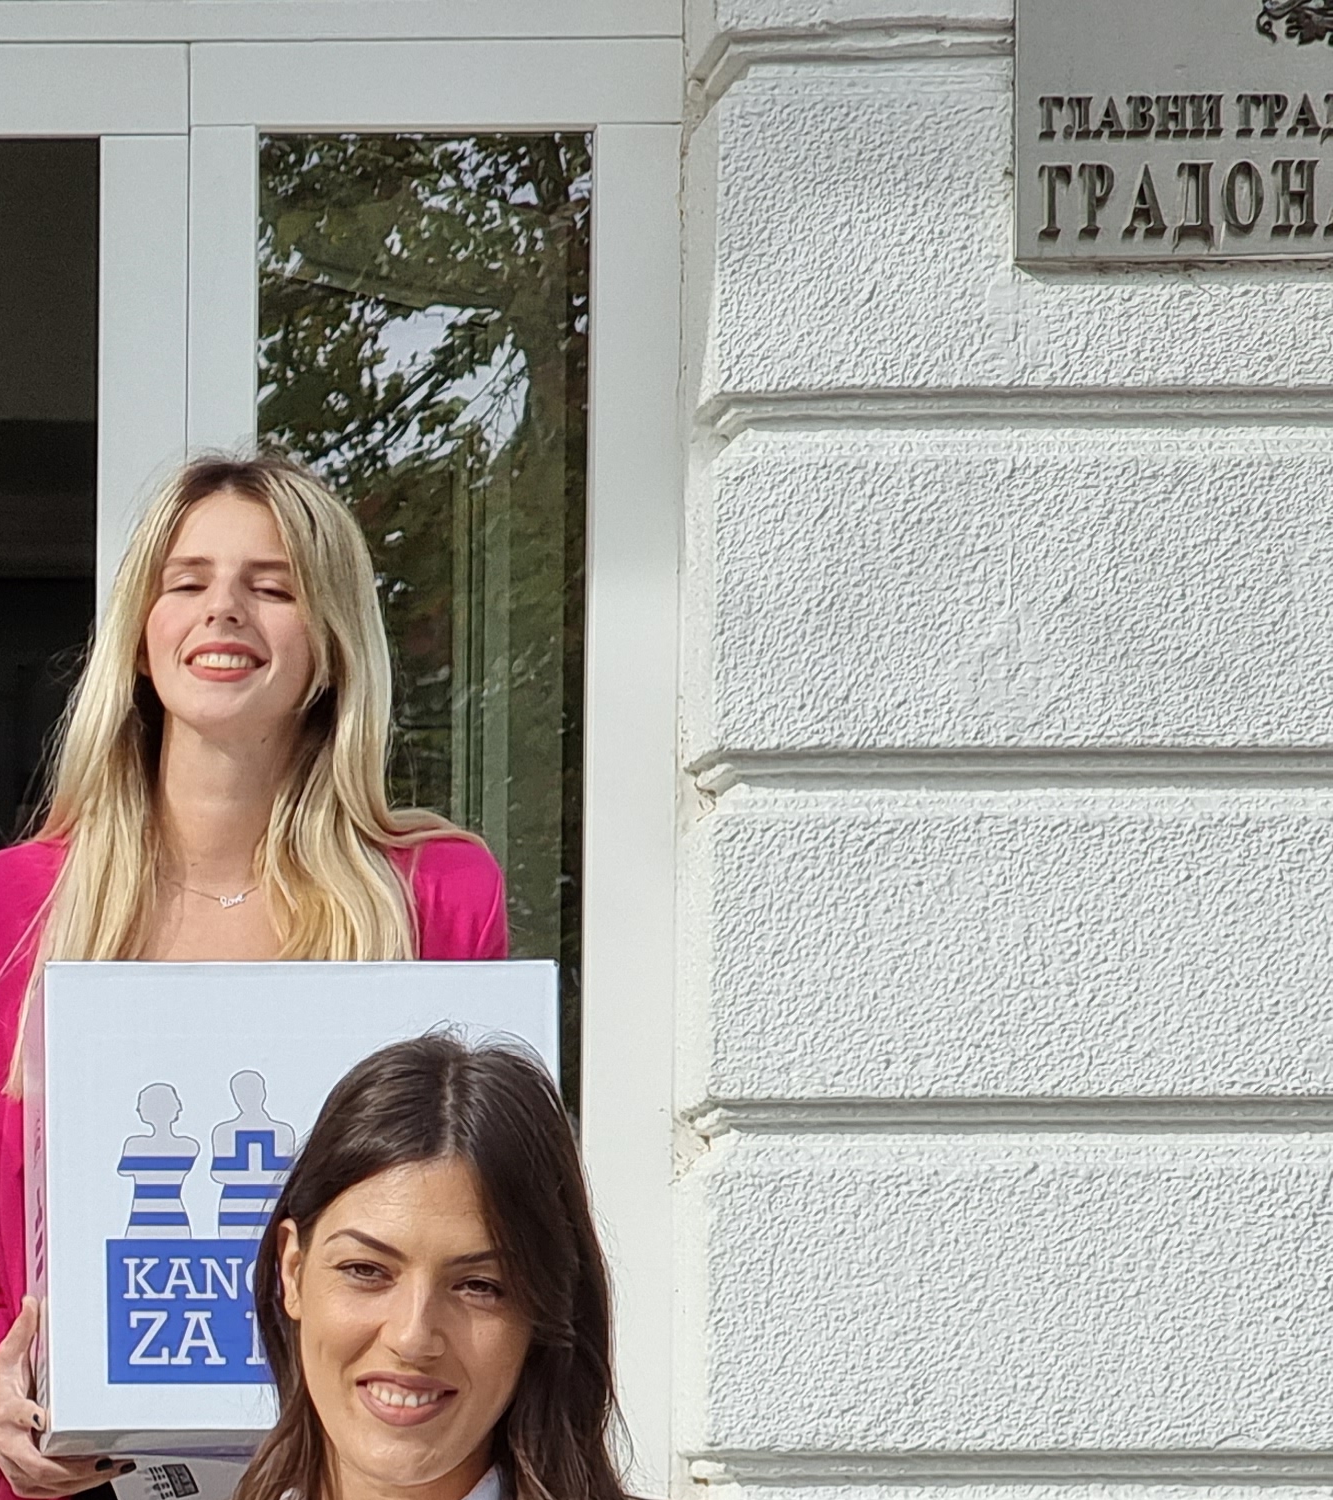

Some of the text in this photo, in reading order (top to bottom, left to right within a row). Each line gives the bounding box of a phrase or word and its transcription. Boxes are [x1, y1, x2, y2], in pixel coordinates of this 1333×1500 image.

[1038, 94, 1225, 142] ГЛАВНИ
[1038, 159, 1333, 254] ГРАДОН
[129, 1311, 227, 1365] ZA
